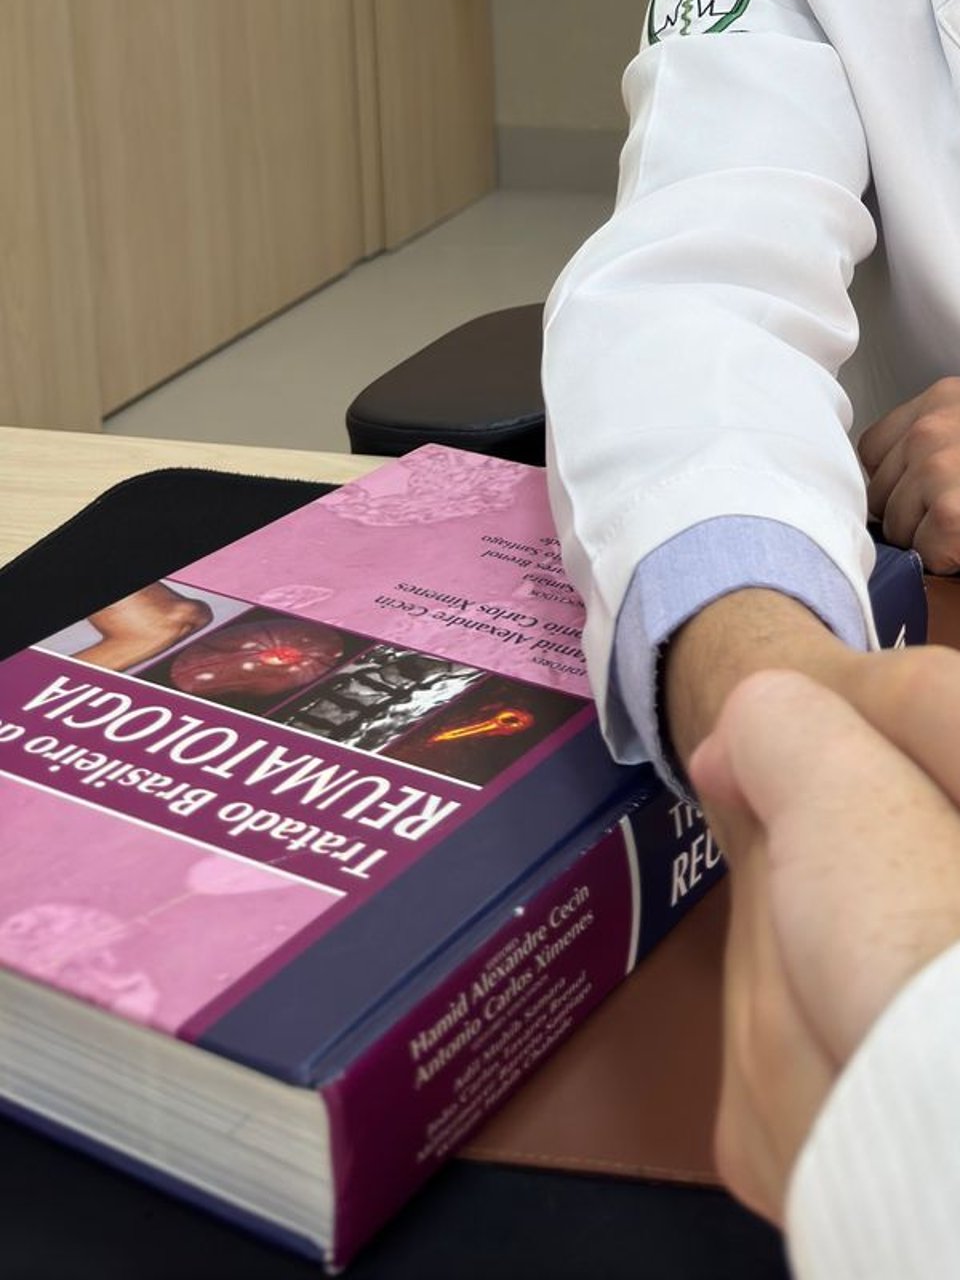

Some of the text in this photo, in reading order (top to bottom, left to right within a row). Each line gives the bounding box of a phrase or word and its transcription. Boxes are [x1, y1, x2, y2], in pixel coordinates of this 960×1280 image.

[480, 549, 533, 570] Brenol
[481, 534, 543, 557] Santiago
[373, 594, 429, 618] Cecin
[394, 582, 476, 611] Ximenes
[431, 608, 535, 646] Alexandre
[476, 604, 538, 629] Carlos
[22, 675, 461, 841] REUMATOLOGIA
[23, 735, 218, 817] Brasileiro
[216, 801, 388, 879] Tratado
[410, 991, 469, 1061] Hamid
[470, 924, 549, 1005] Alexandre
[550, 884, 591, 928] Cecin
[414, 1018, 482, 1091] Antonio
[484, 971, 534, 1020] Carlos
[535, 909, 595, 973] Ximenes
